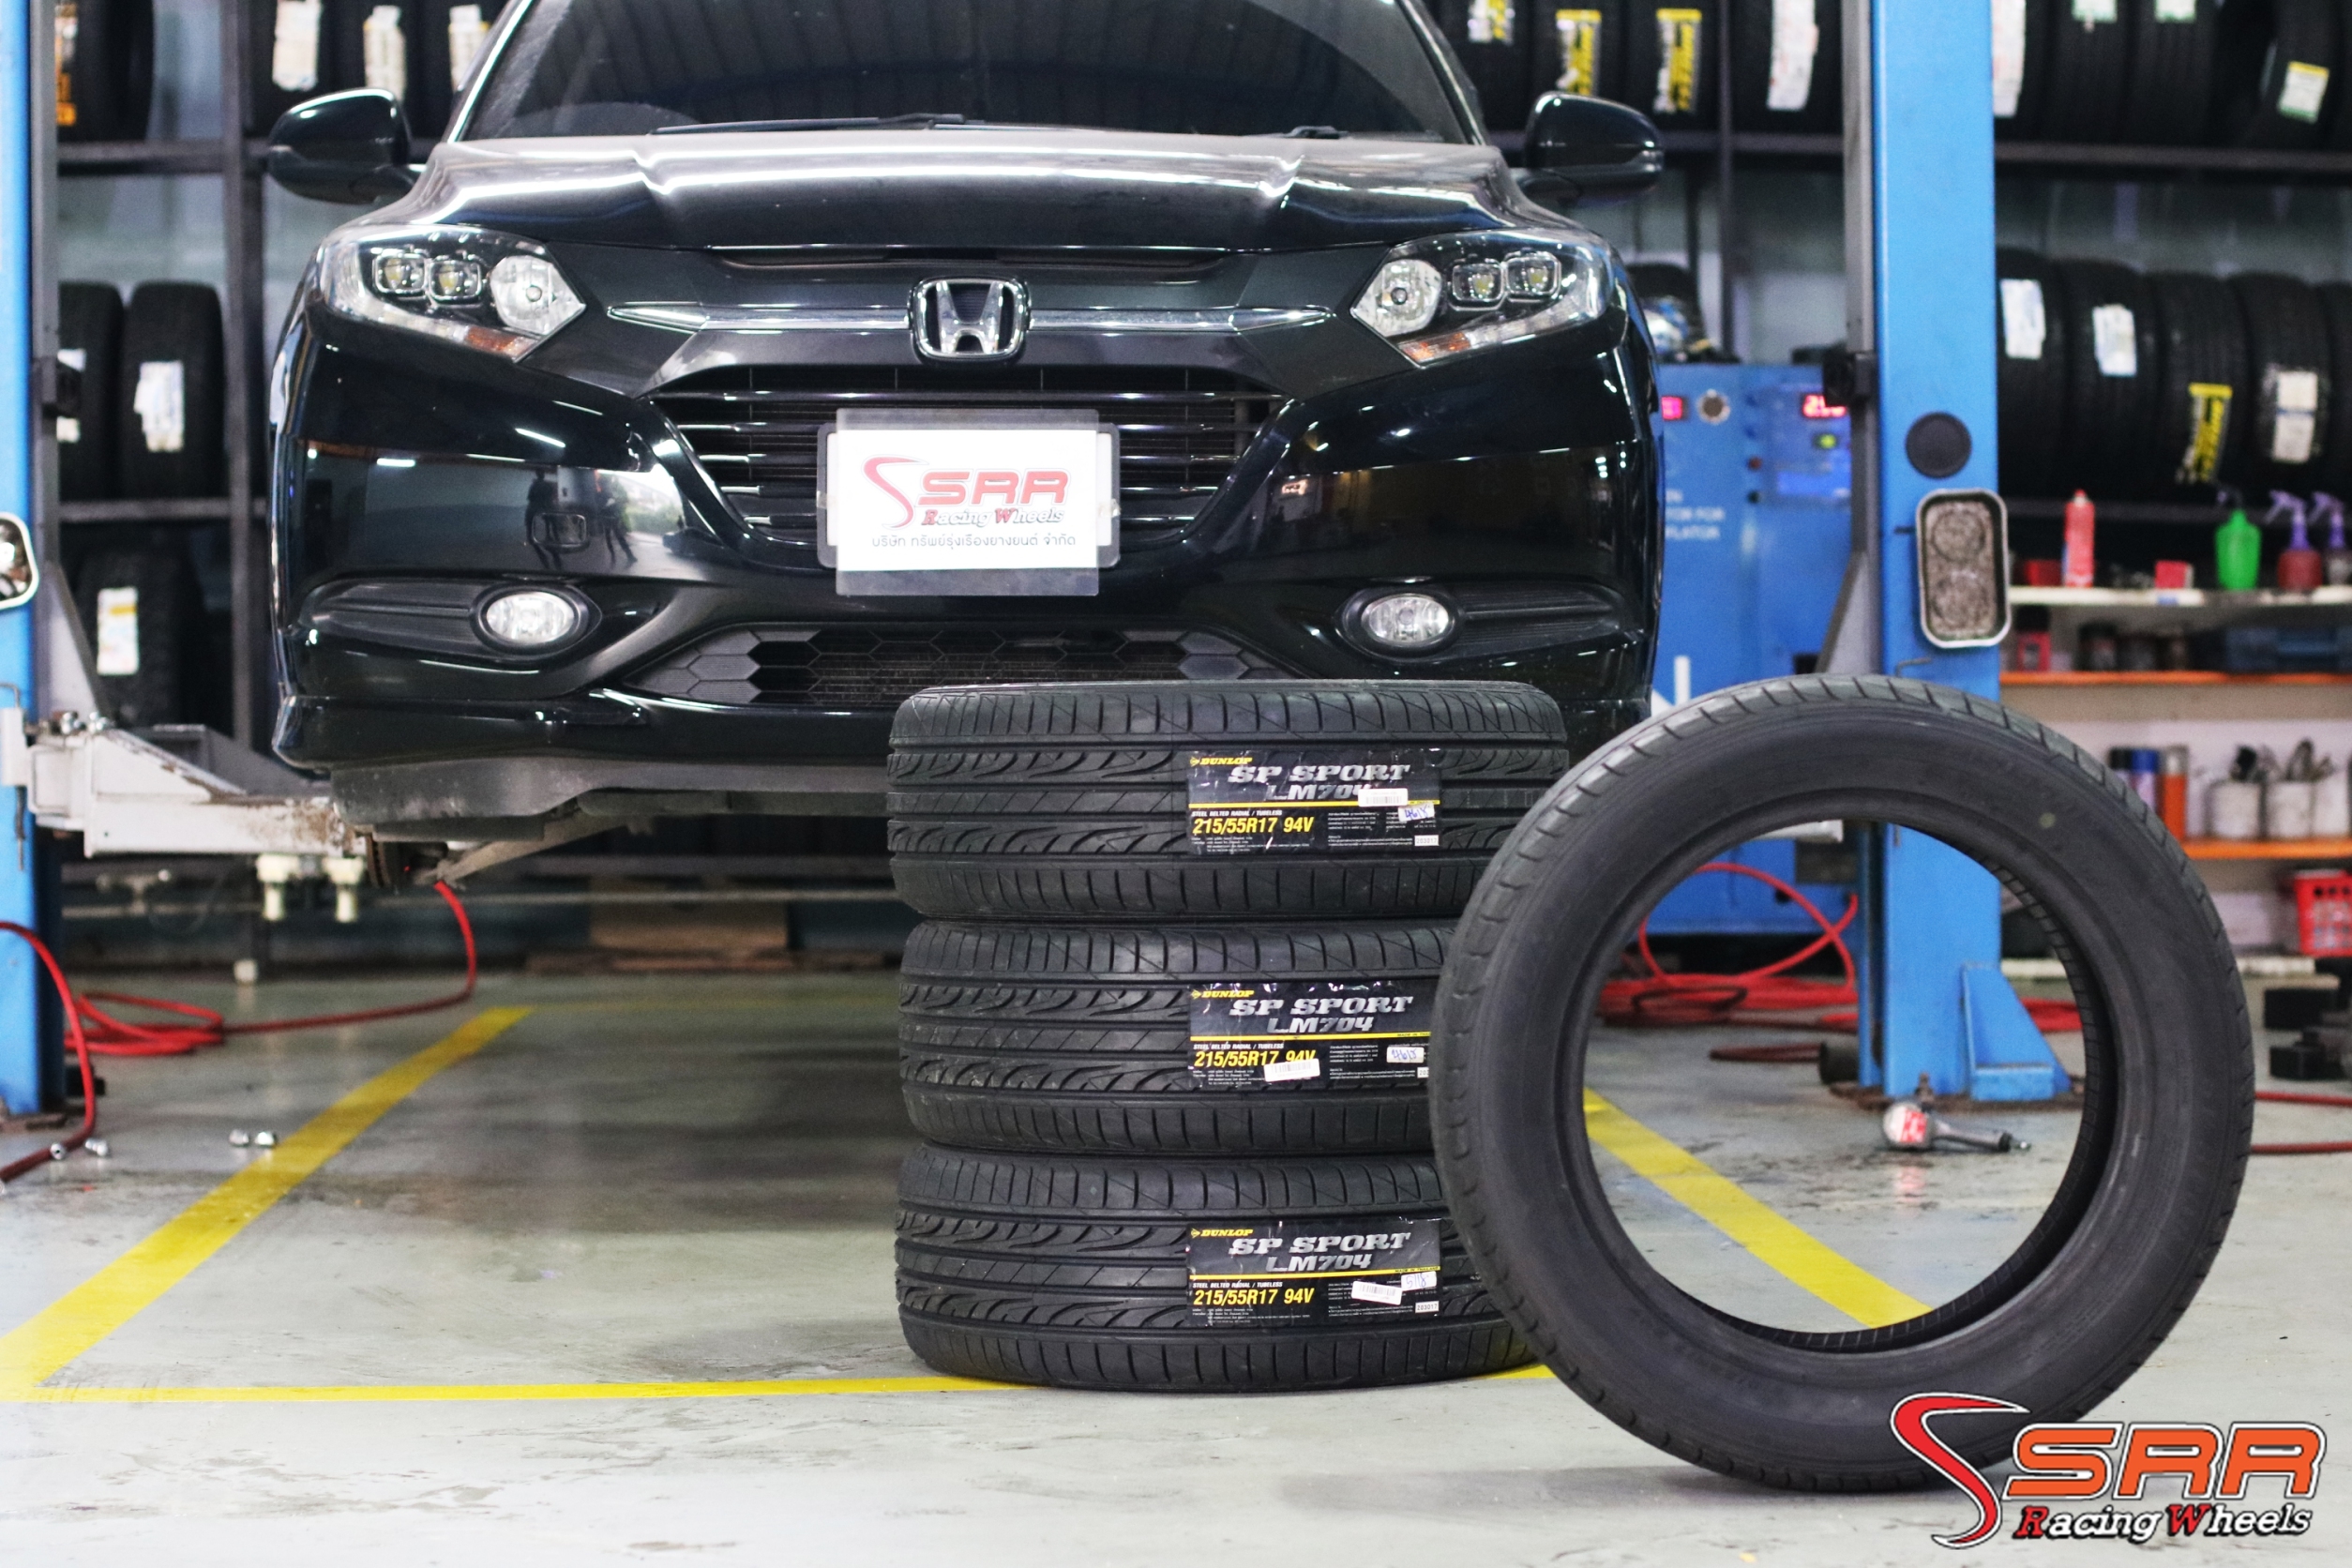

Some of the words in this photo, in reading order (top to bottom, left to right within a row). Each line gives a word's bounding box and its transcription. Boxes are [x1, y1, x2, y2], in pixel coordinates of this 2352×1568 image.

[921, 507, 991, 528] Racing
[995, 507, 1064, 525] Wheels
[872, 534, 906, 548] บริษัท
[1044, 532, 1077, 547] จำกัด
[1199, 757, 1253, 765] DUNLOP
[1228, 766, 1283, 783] SP
[1289, 764, 1411, 782] SPORT
[1192, 817, 1278, 835] 215/55R17
[1283, 817, 1315, 833] 94V
[1200, 989, 1255, 999] DUNLOP
[1229, 999, 1284, 1016] SP
[1289, 996, 1413, 1016] SPORT
[1266, 1017, 1374, 1033] LM704
[1194, 1050, 1279, 1068] 215/55R17
[1286, 1049, 1316, 1063] 94V
[1200, 1229, 1253, 1237] DUNLOP
[1229, 1238, 1283, 1255] SP
[1289, 1232, 1411, 1253] SPORT
[1266, 1254, 1372, 1272] LM704
[1193, 1289, 1278, 1306] 215/55R17
[1284, 1288, 1315, 1304] 94V
